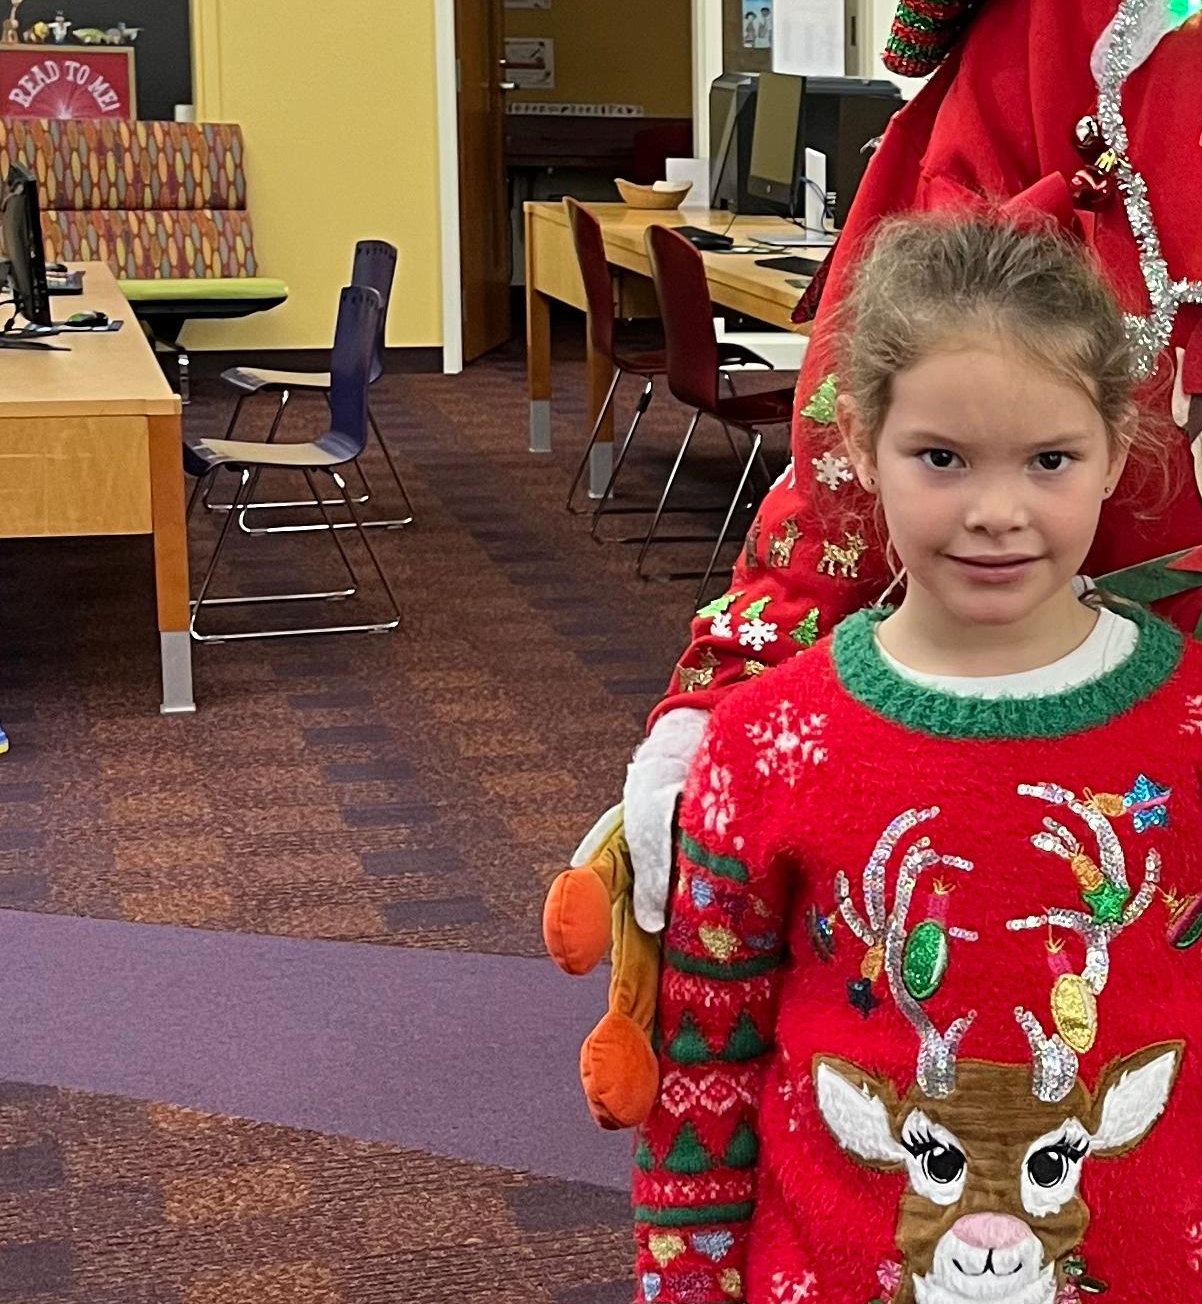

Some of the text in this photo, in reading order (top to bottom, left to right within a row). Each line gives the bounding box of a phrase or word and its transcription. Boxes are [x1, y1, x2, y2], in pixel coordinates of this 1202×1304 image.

[8, 60, 121, 112] READ TO ME!
